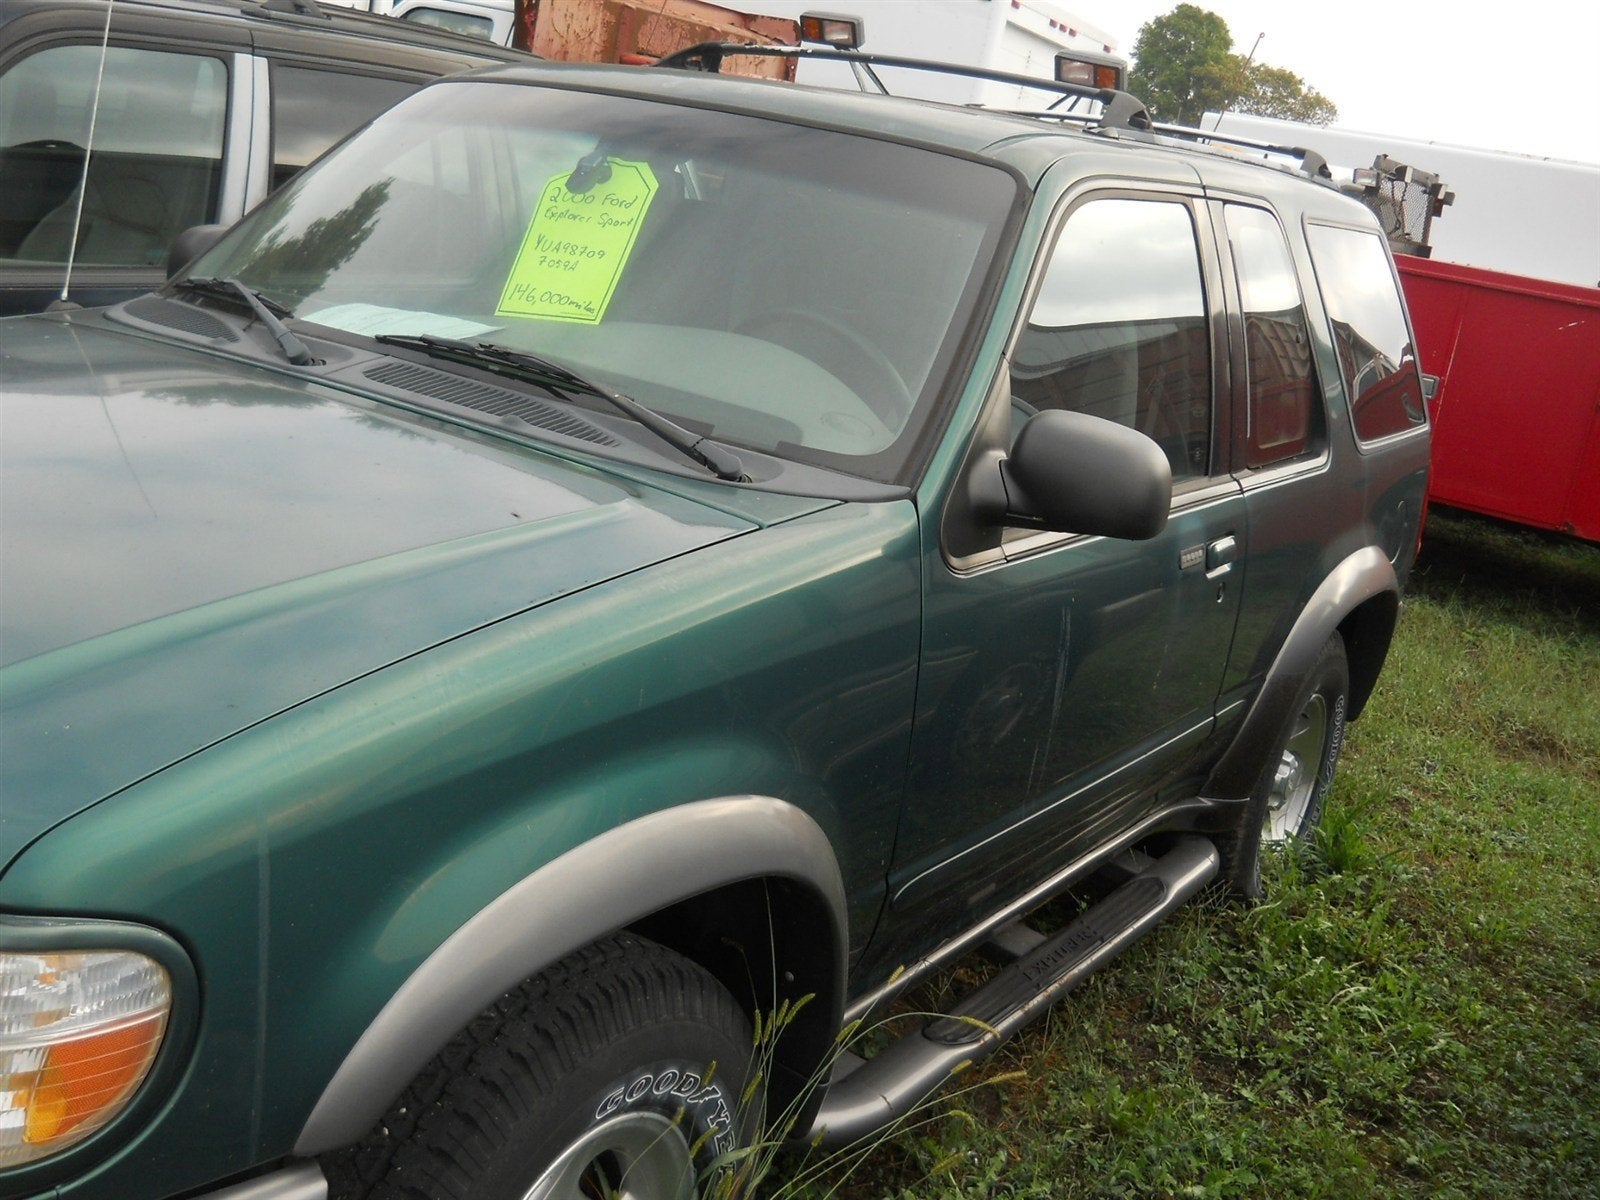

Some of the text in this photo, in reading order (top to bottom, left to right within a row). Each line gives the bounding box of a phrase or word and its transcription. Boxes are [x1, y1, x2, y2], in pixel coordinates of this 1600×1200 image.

[550, 187, 638, 209] 2000 Ford
[544, 206, 634, 228] Explorer Sport
[595, 1069, 737, 1182] GOODYE
